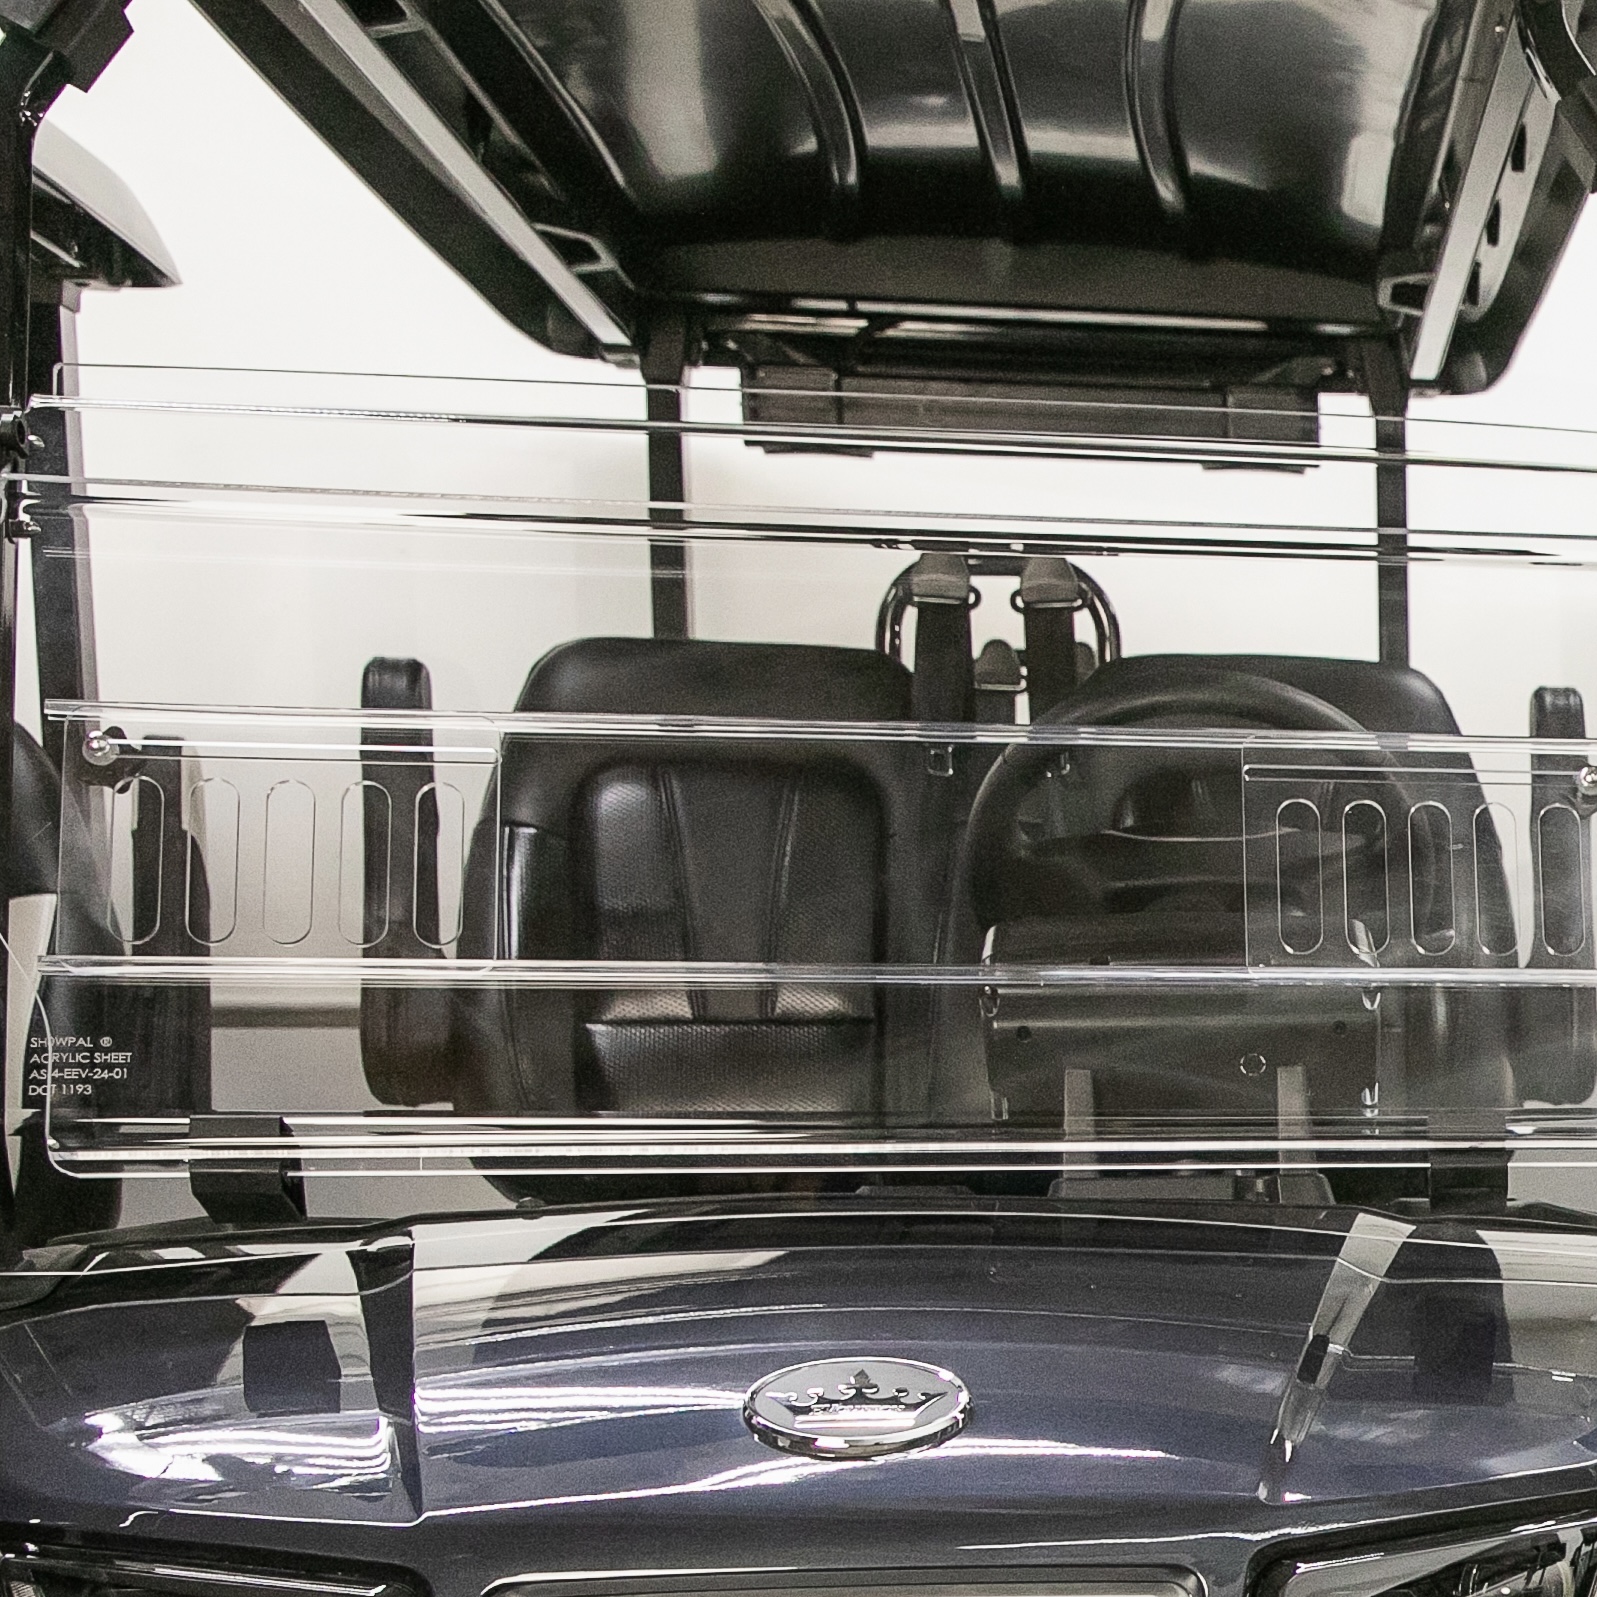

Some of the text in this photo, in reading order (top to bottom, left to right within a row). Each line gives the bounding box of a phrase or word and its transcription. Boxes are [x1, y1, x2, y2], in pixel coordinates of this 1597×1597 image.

[30, 1036, 93, 1048] SHOWPAL
[30, 1052, 132, 1064] ACRYLIC SHEET
[28, 1084, 92, 1096] DOT 1193
